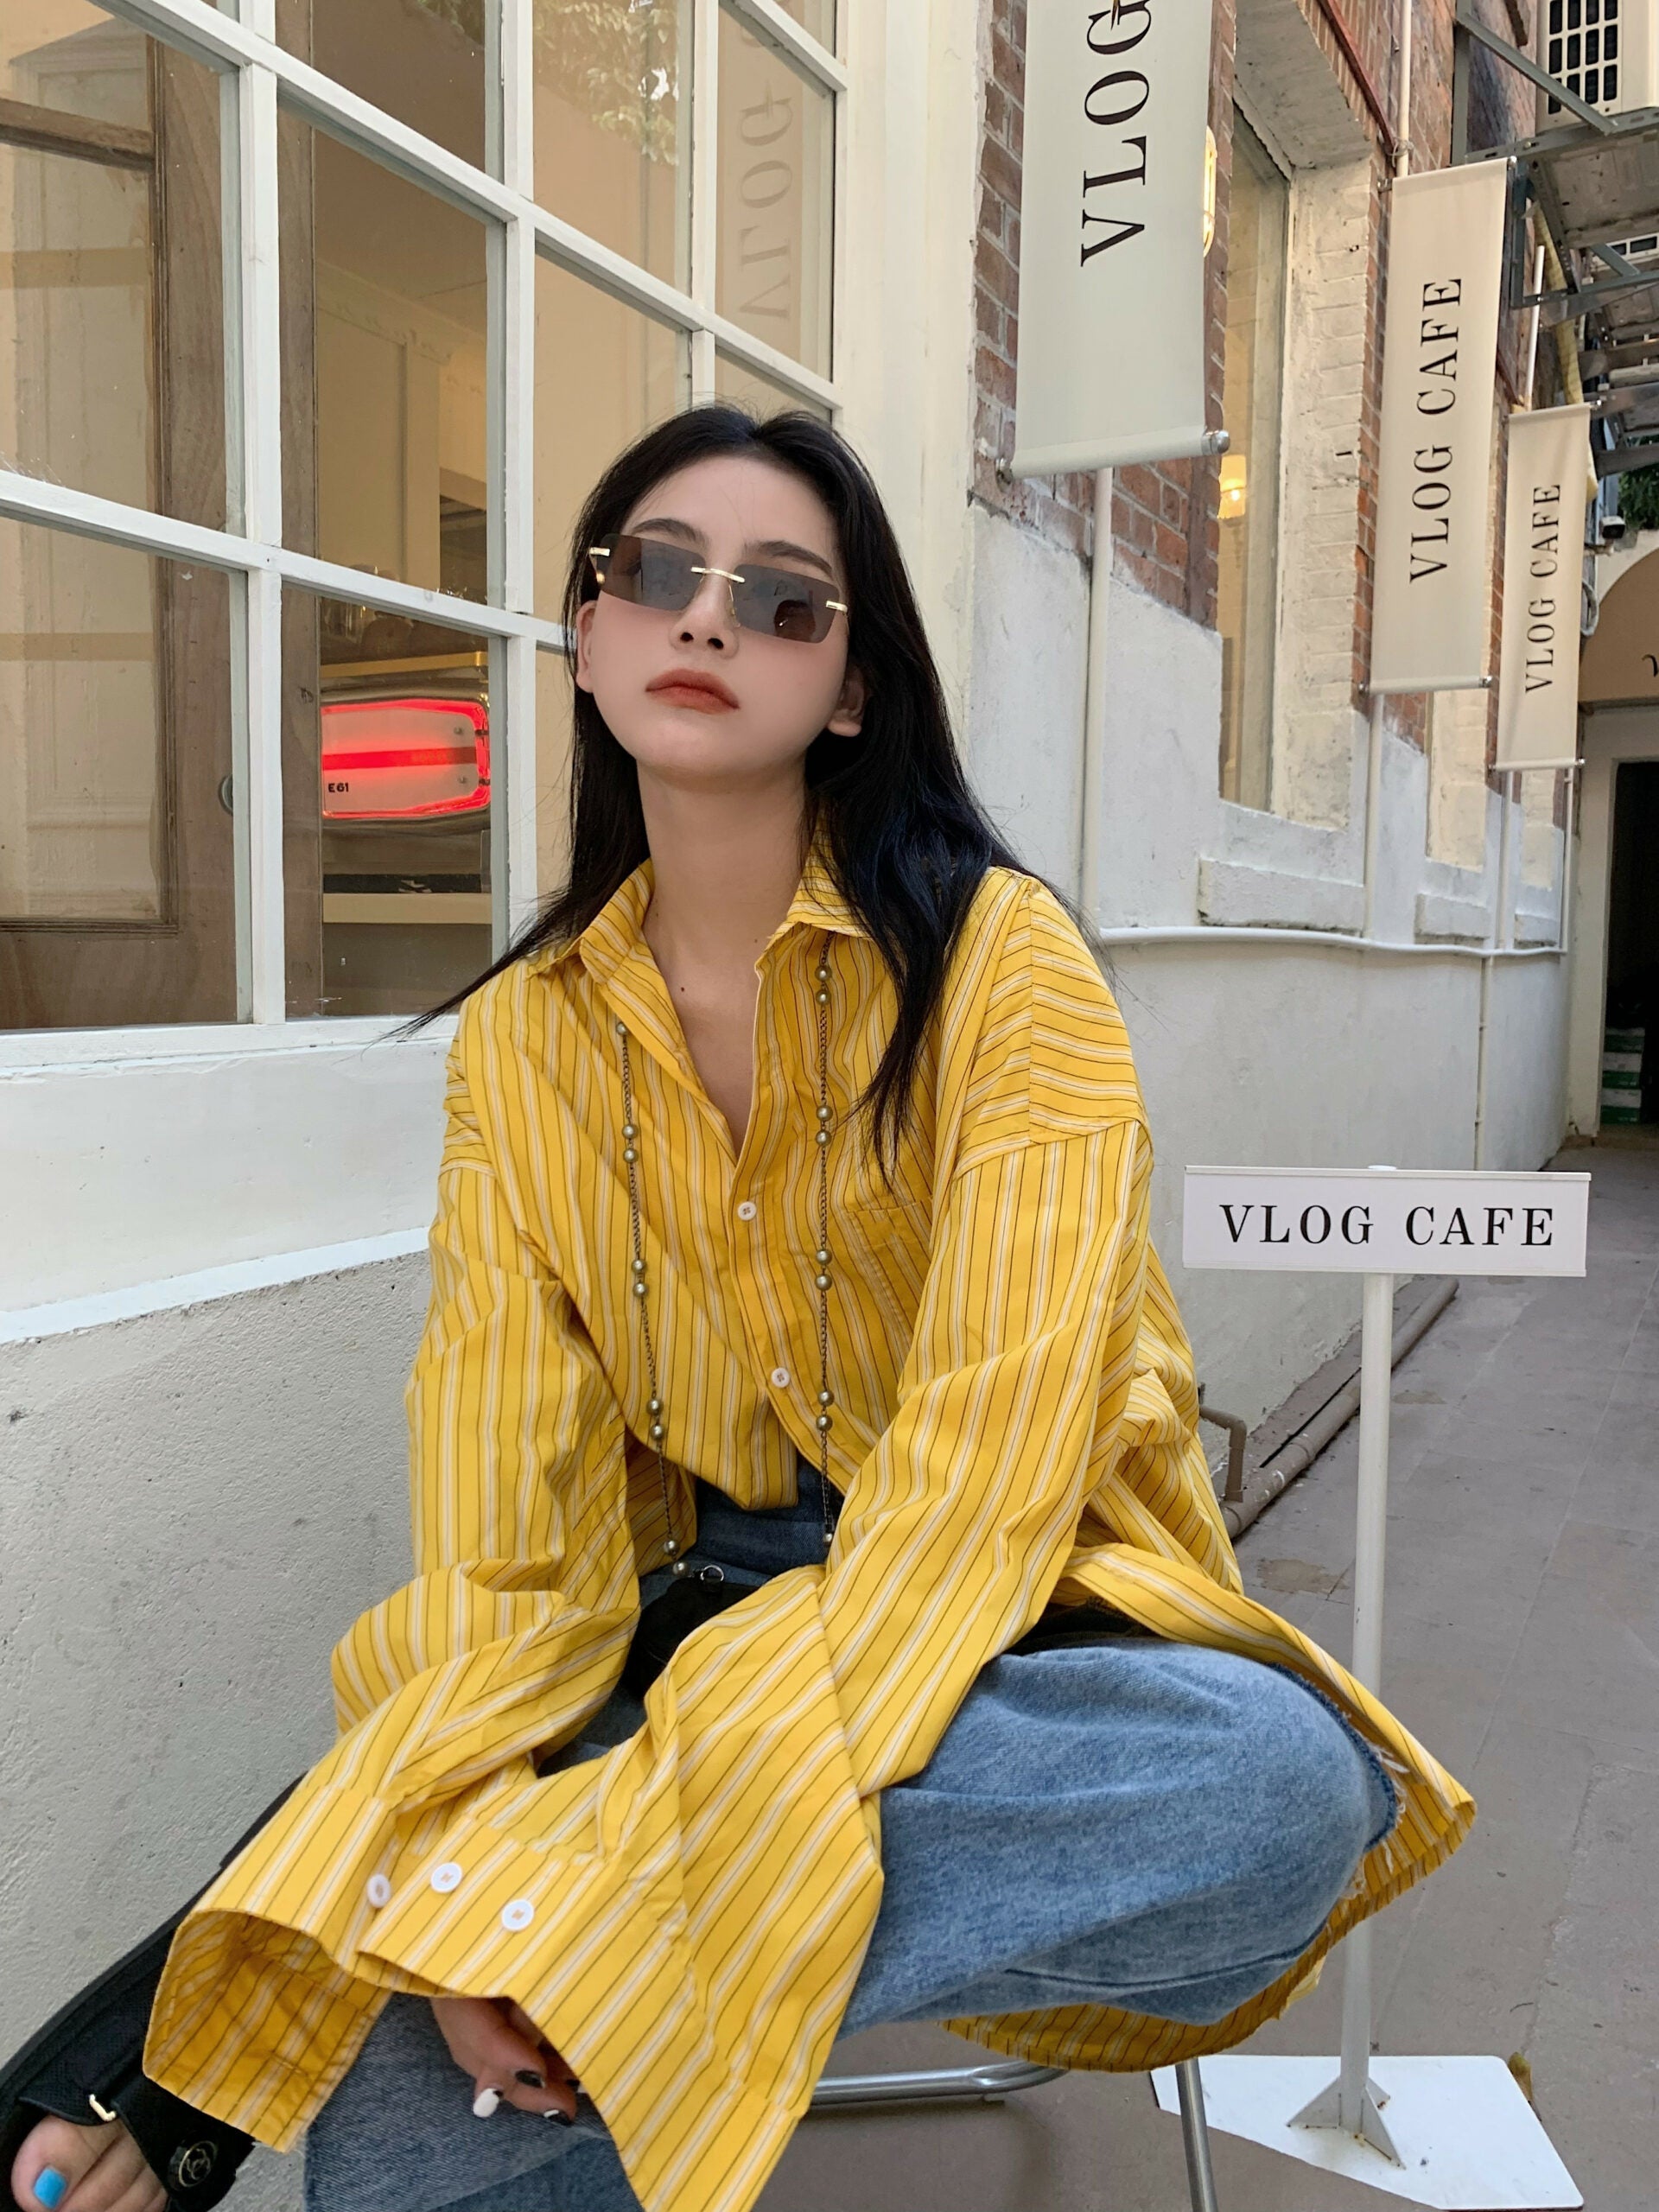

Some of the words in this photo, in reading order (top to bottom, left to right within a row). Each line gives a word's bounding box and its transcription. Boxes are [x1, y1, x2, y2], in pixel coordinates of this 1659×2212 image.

[1081, 0, 1151, 266] VLOG
[1417, 278, 1462, 416] CAFE
[1409, 444, 1453, 583] VLOG
[1530, 484, 1560, 580] CAFE
[1525, 597, 1556, 695] VLOG
[328, 782, 349, 793] E61
[1218, 1204, 1374, 1245] VLOG
[1406, 1206, 1554, 1246] CAFE
